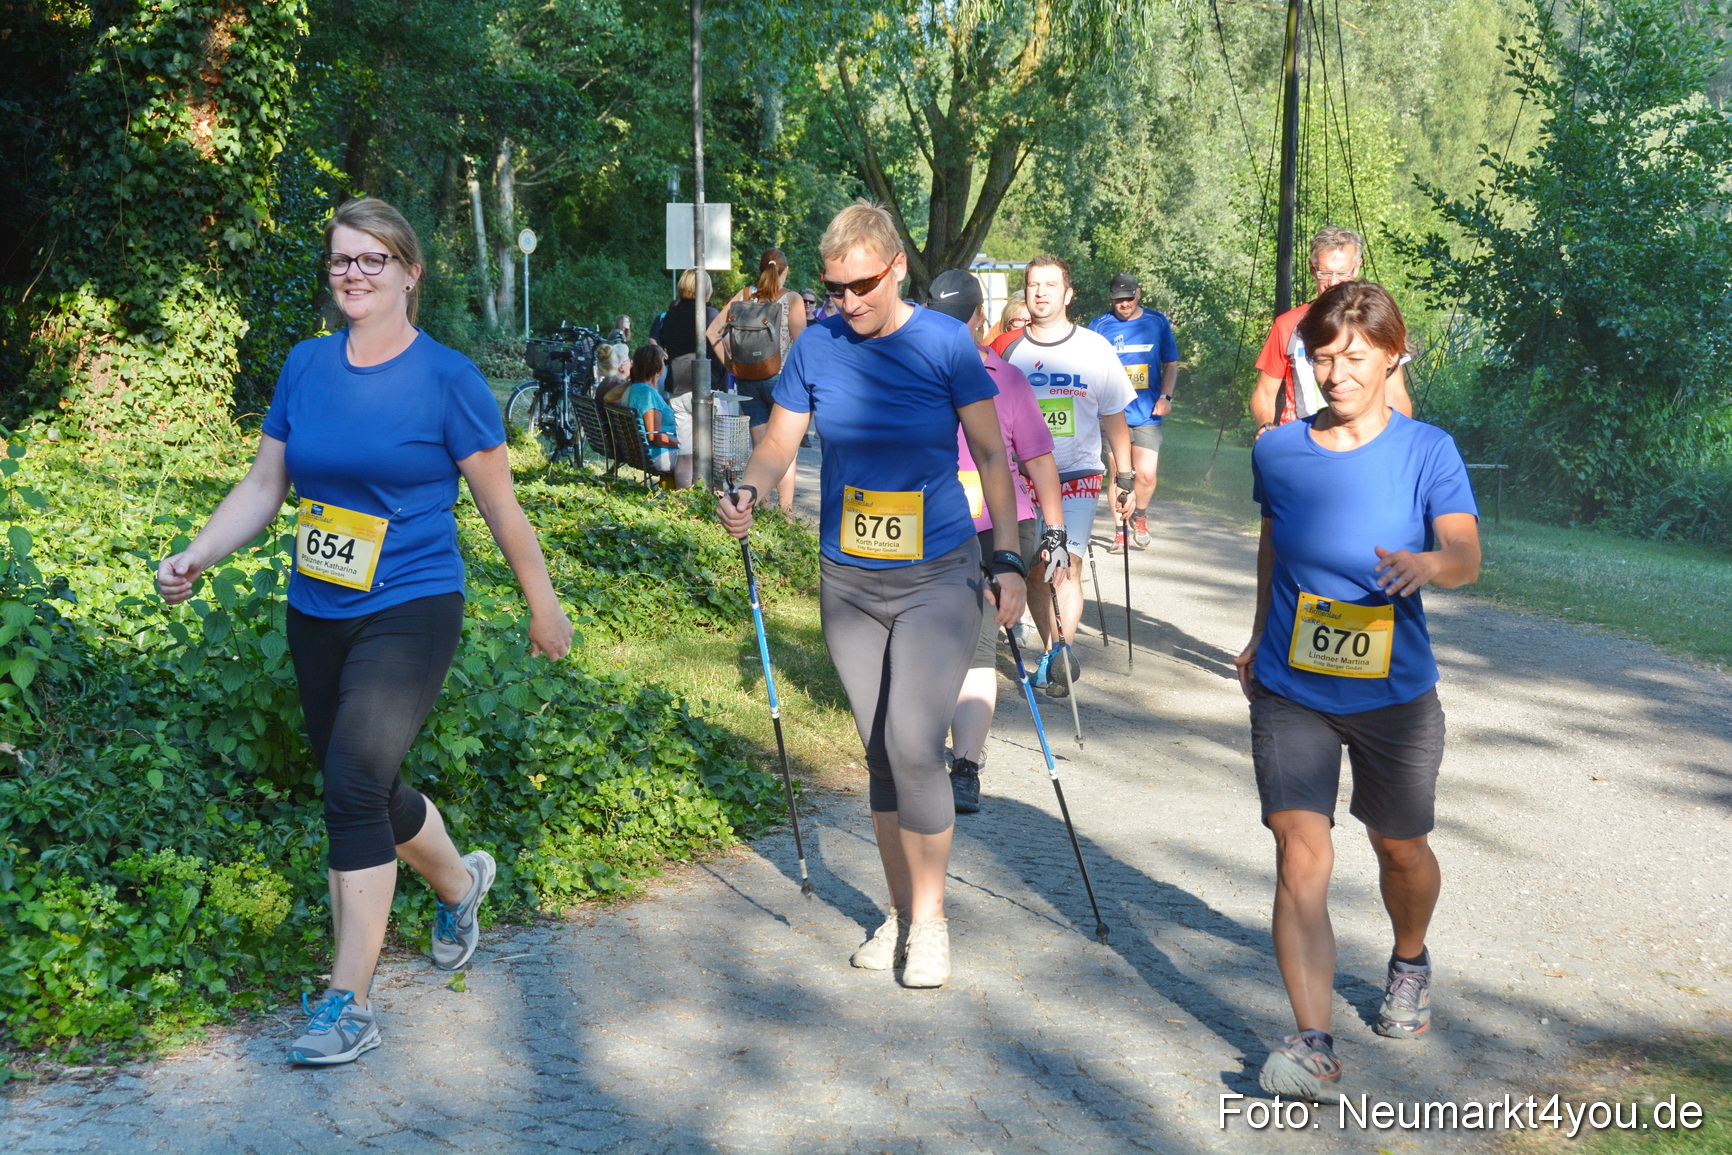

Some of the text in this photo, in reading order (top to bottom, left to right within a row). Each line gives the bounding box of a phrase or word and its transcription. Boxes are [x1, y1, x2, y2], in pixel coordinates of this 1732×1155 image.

[1049, 386, 1087, 397] energie
[855, 514, 901, 540] 676
[307, 529, 355, 564] 654
[855, 537, 900, 548] Korth Patricia
[315, 566, 330, 575] Berger
[330, 570, 345, 578] GmbH
[324, 559, 357, 575] Katharina
[1313, 626, 1370, 657] 670
[1308, 651, 1338, 662] Lindner
[1340, 656, 1370, 666] Martina
